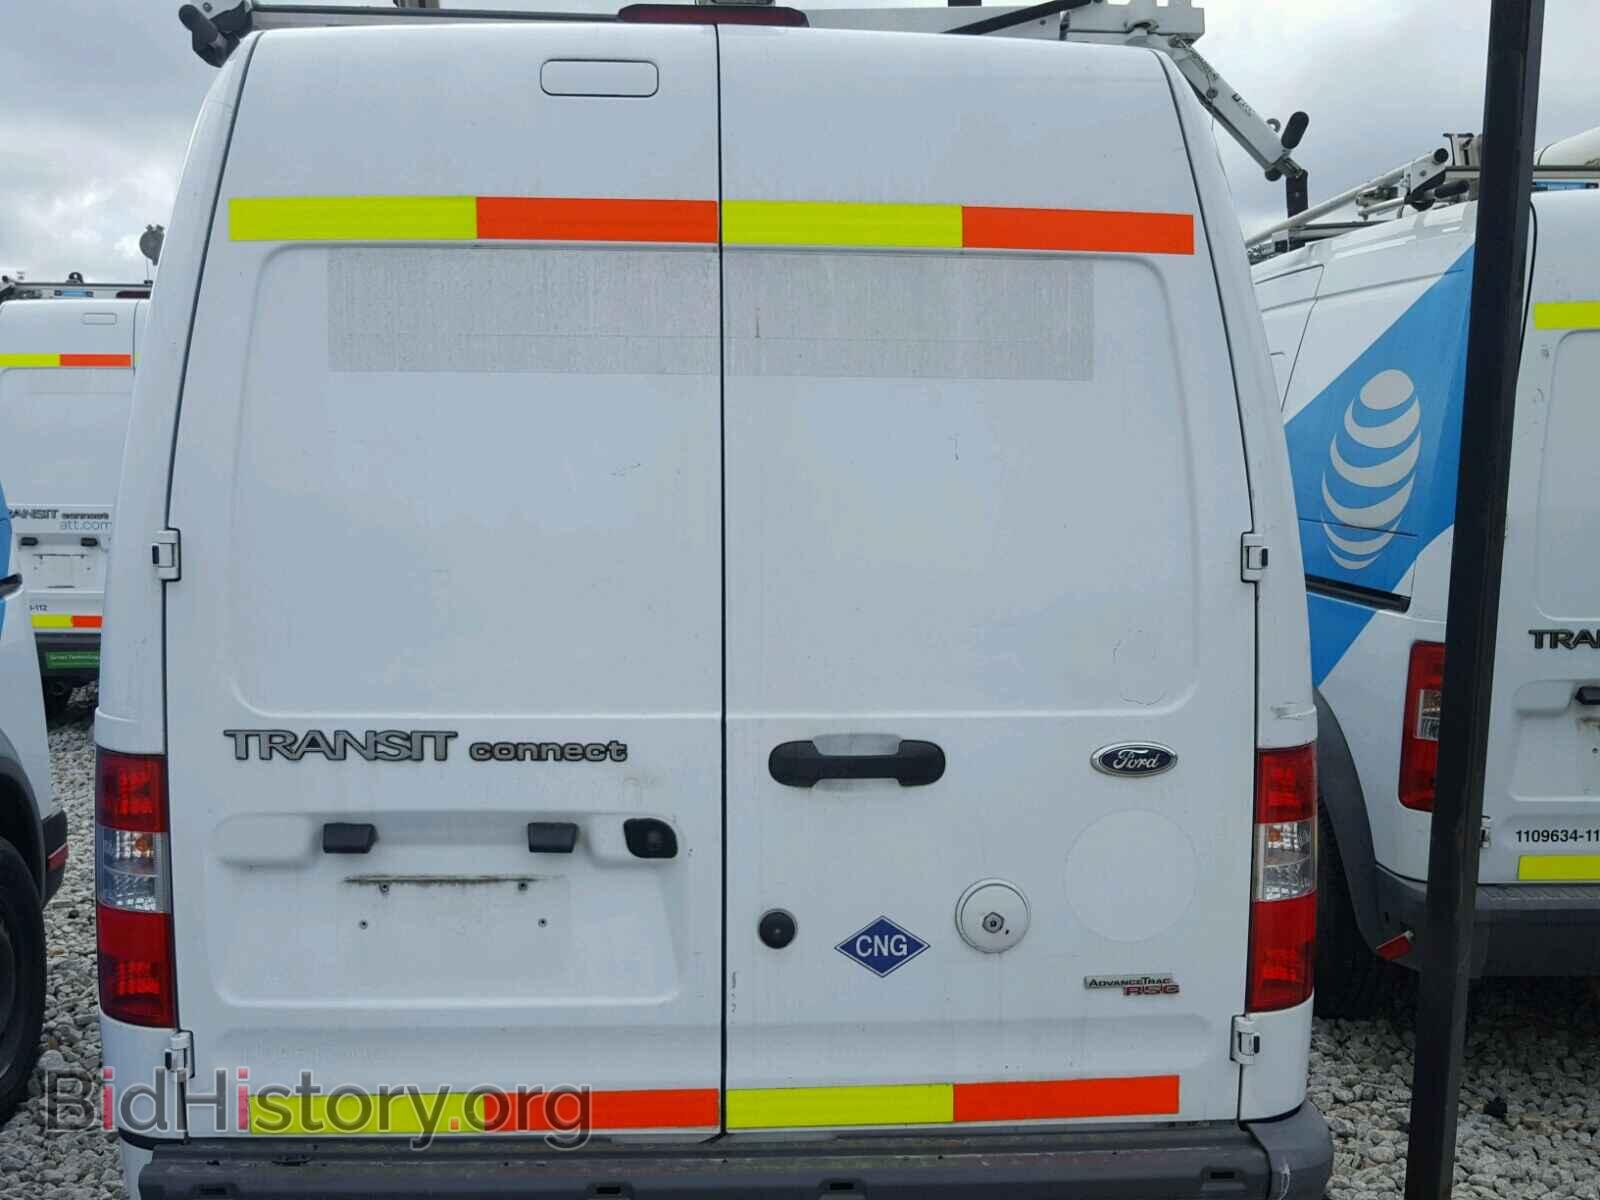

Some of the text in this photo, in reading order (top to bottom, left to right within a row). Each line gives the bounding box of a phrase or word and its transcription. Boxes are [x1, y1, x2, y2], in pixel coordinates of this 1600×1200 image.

[1528, 628, 1600, 651] TRA
[224, 729, 629, 764] TRANSIT connect
[1112, 748, 1161, 769] Ford
[1515, 828, 1600, 844] 1109634-11
[855, 933, 909, 958] CNG
[1122, 983, 1181, 997] RSC
